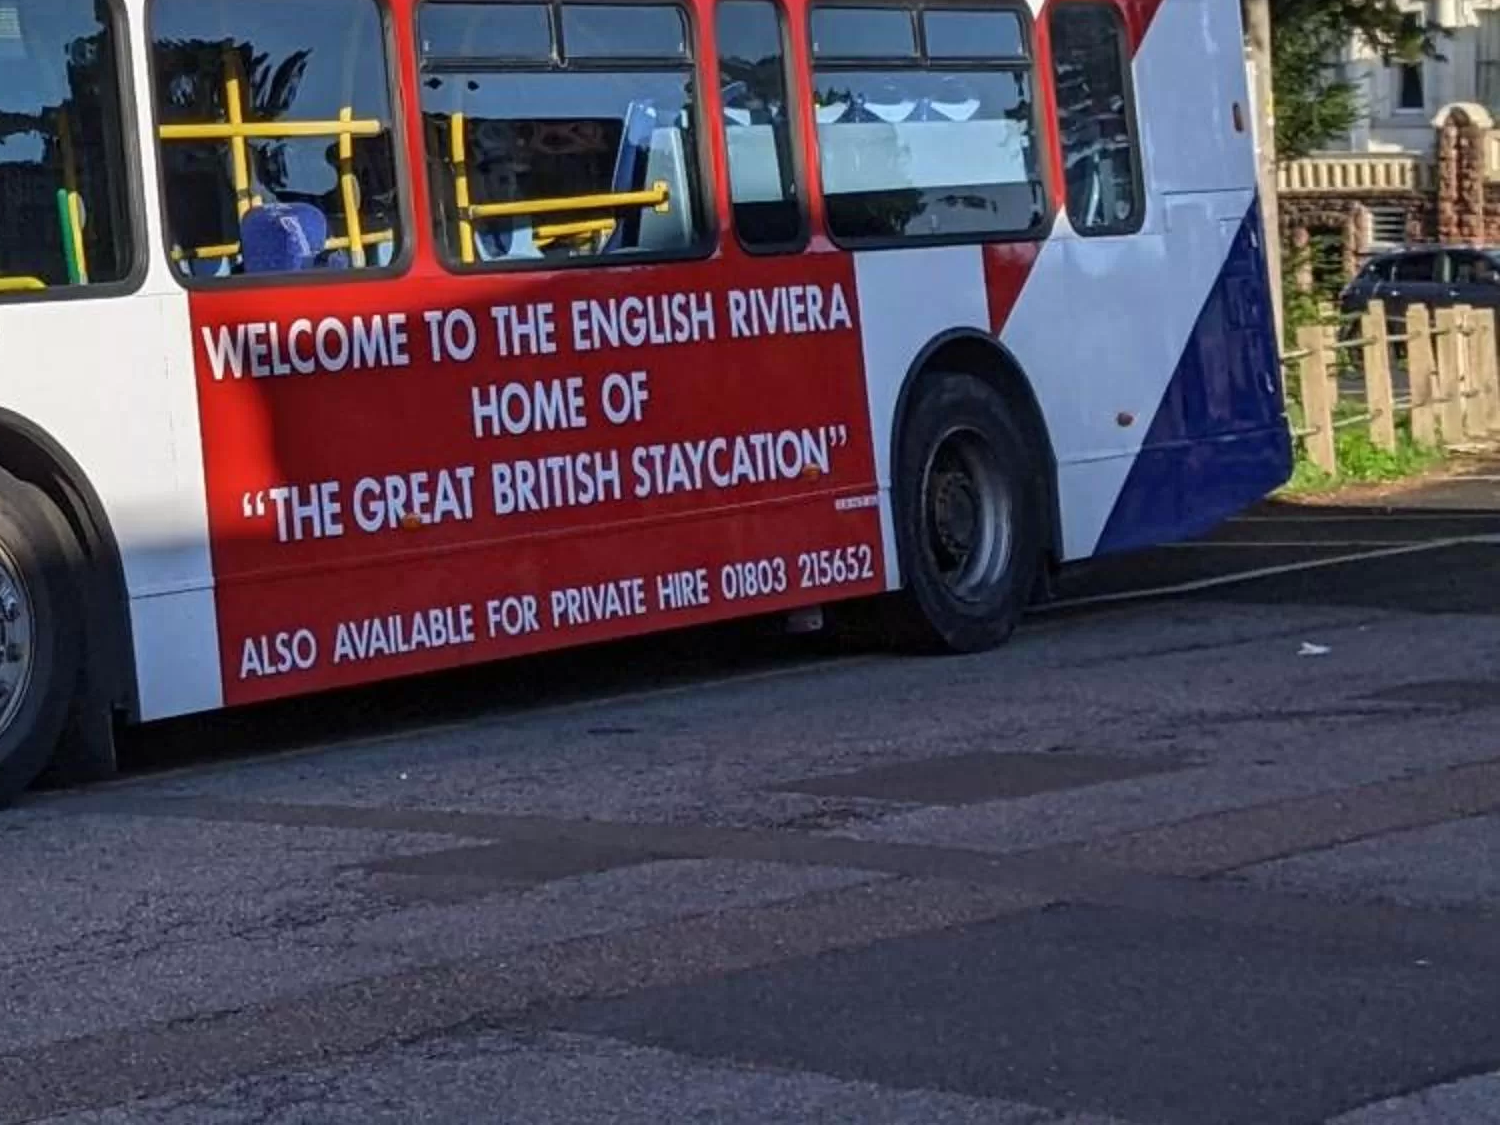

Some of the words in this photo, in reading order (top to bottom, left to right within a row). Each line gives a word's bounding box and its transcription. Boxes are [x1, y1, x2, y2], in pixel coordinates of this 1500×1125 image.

[203, 312, 409, 379] WELCOME
[424, 309, 477, 362] TO
[491, 302, 556, 356] THE
[573, 291, 714, 350] ENGLISH
[728, 283, 851, 337] RIVIERA
[471, 379, 585, 438] HOME
[601, 371, 649, 422] OF
[354, 466, 474, 532] GREAT
[492, 450, 620, 511] BRITISH
[239, 629, 316, 679] ALSO
[334, 604, 475, 664] AVAILABLE
[487, 596, 539, 636] FOR
[551, 578, 647, 627] PRIVATE
[657, 569, 709, 610] HIRE
[722, 557, 787, 600] 01803
[798, 545, 874, 588] 215652
